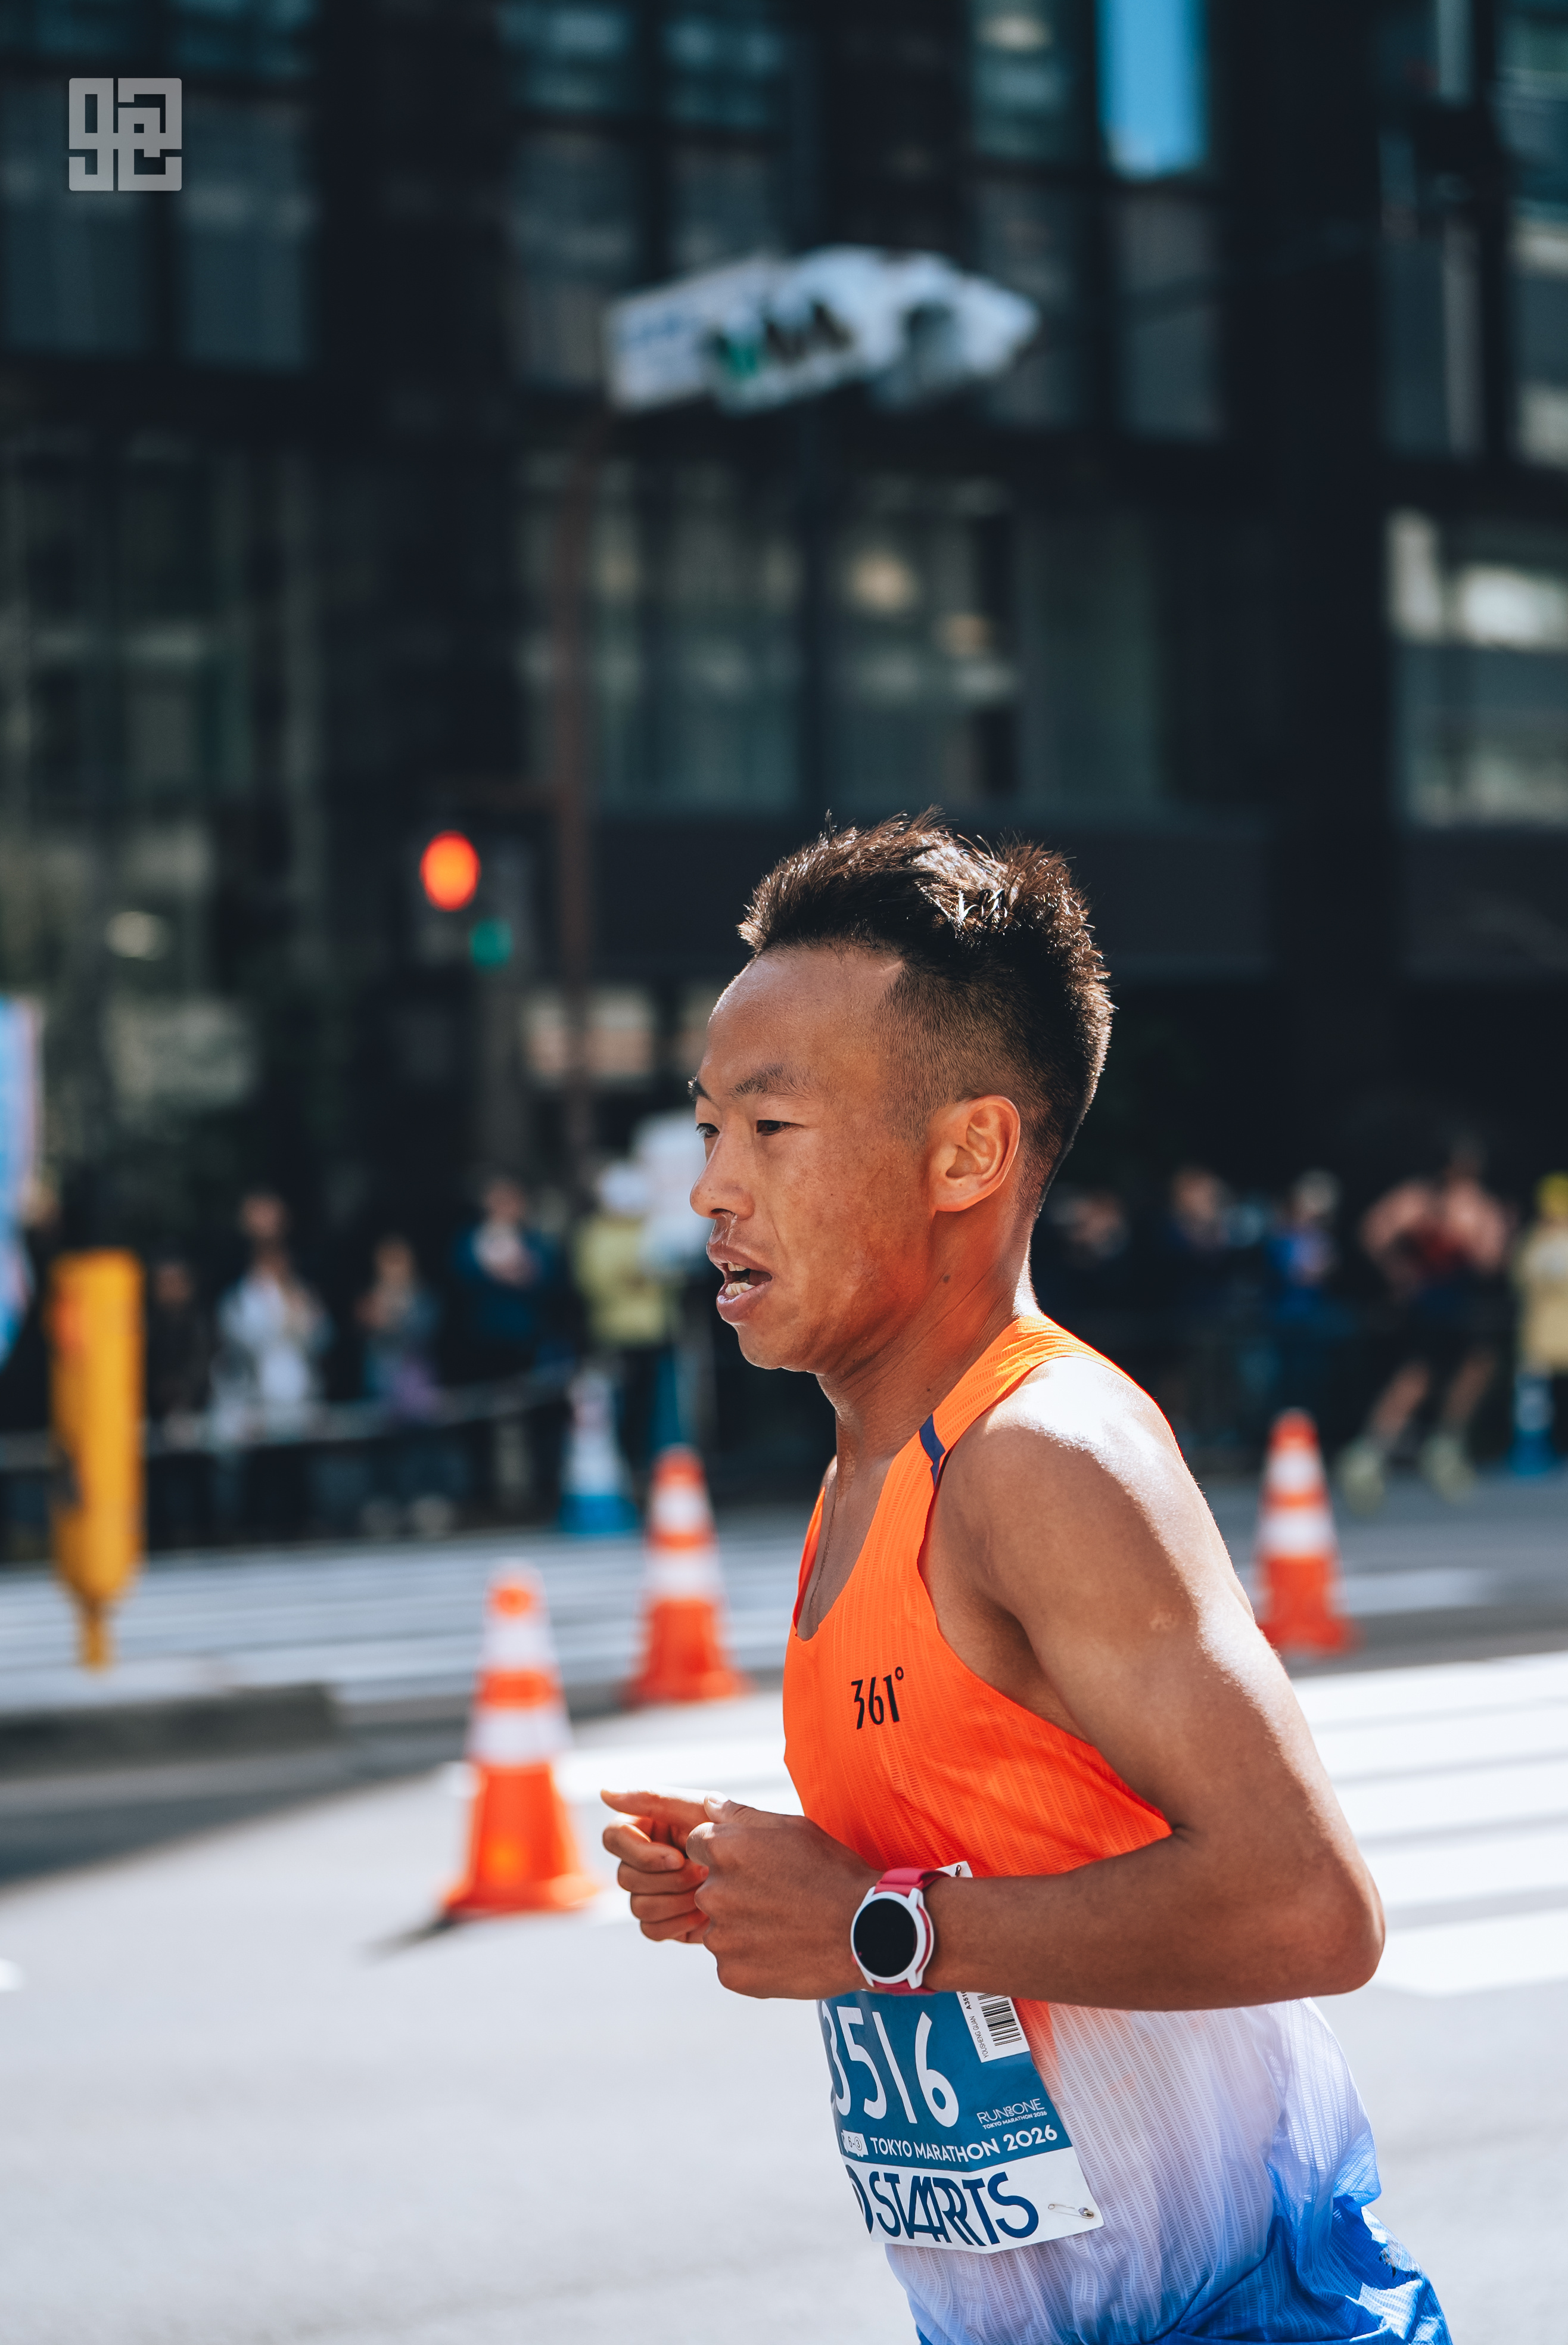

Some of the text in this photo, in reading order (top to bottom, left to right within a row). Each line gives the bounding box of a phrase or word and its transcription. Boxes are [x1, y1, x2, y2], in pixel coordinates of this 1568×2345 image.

[851, 1666, 904, 1730] 361°
[969, 2016, 978, 2030] GUAN
[975, 2031, 989, 2058] YOUSHENG
[822, 2001, 959, 2128] 3516
[982, 2122, 1002, 2130] TOKYO
[1002, 2114, 1033, 2125] MARATHON
[870, 2125, 1057, 2162] TOKYO MARATHON 2026
